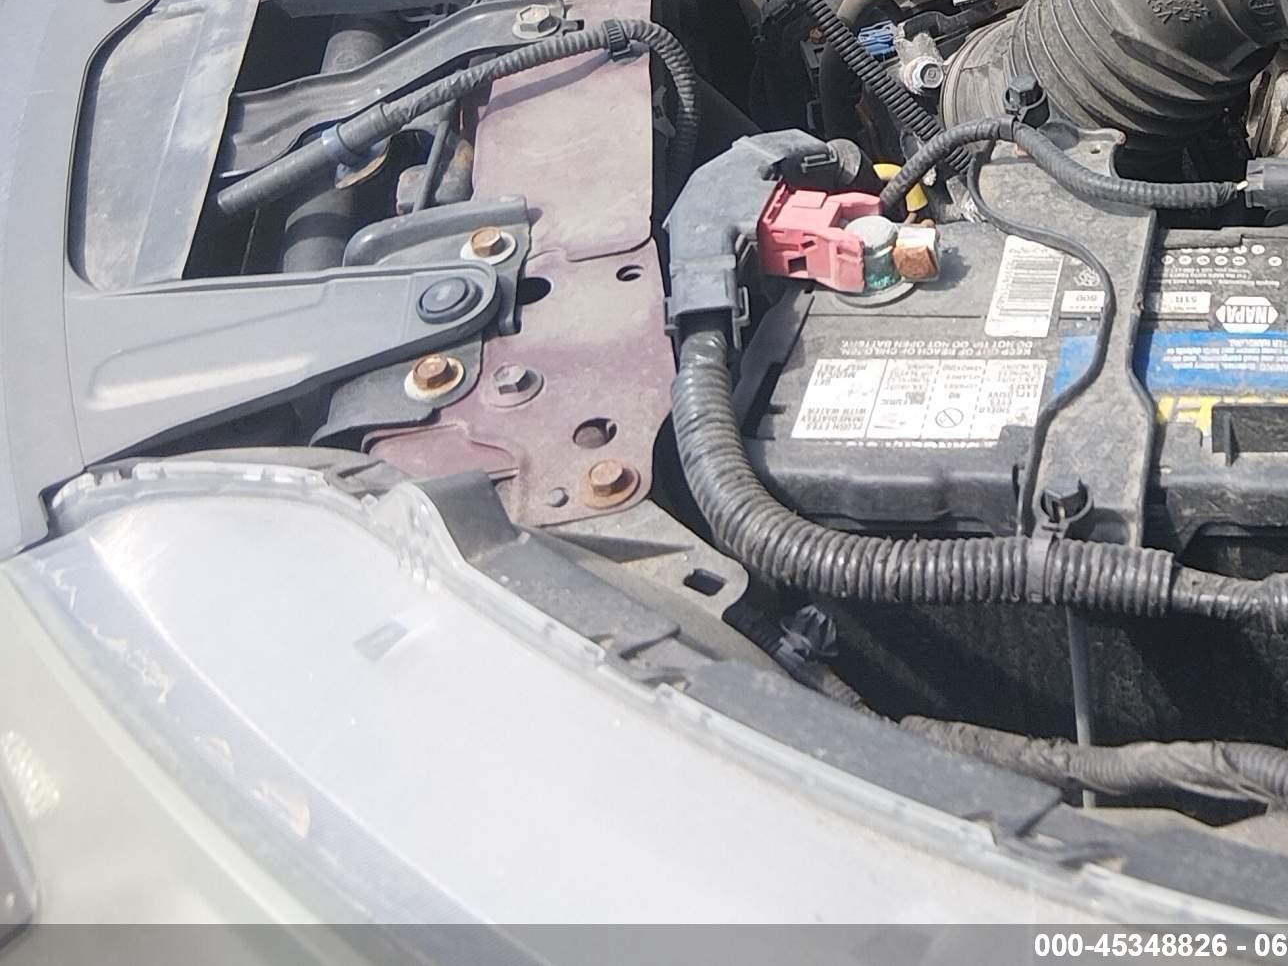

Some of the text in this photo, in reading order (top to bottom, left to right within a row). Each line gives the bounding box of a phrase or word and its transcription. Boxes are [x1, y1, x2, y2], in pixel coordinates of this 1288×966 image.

[1226, 305, 1268, 324] NAPA
[893, 340, 924, 348] OPEN
[927, 340, 950, 348] NOT
[915, 347, 956, 355] REACH
